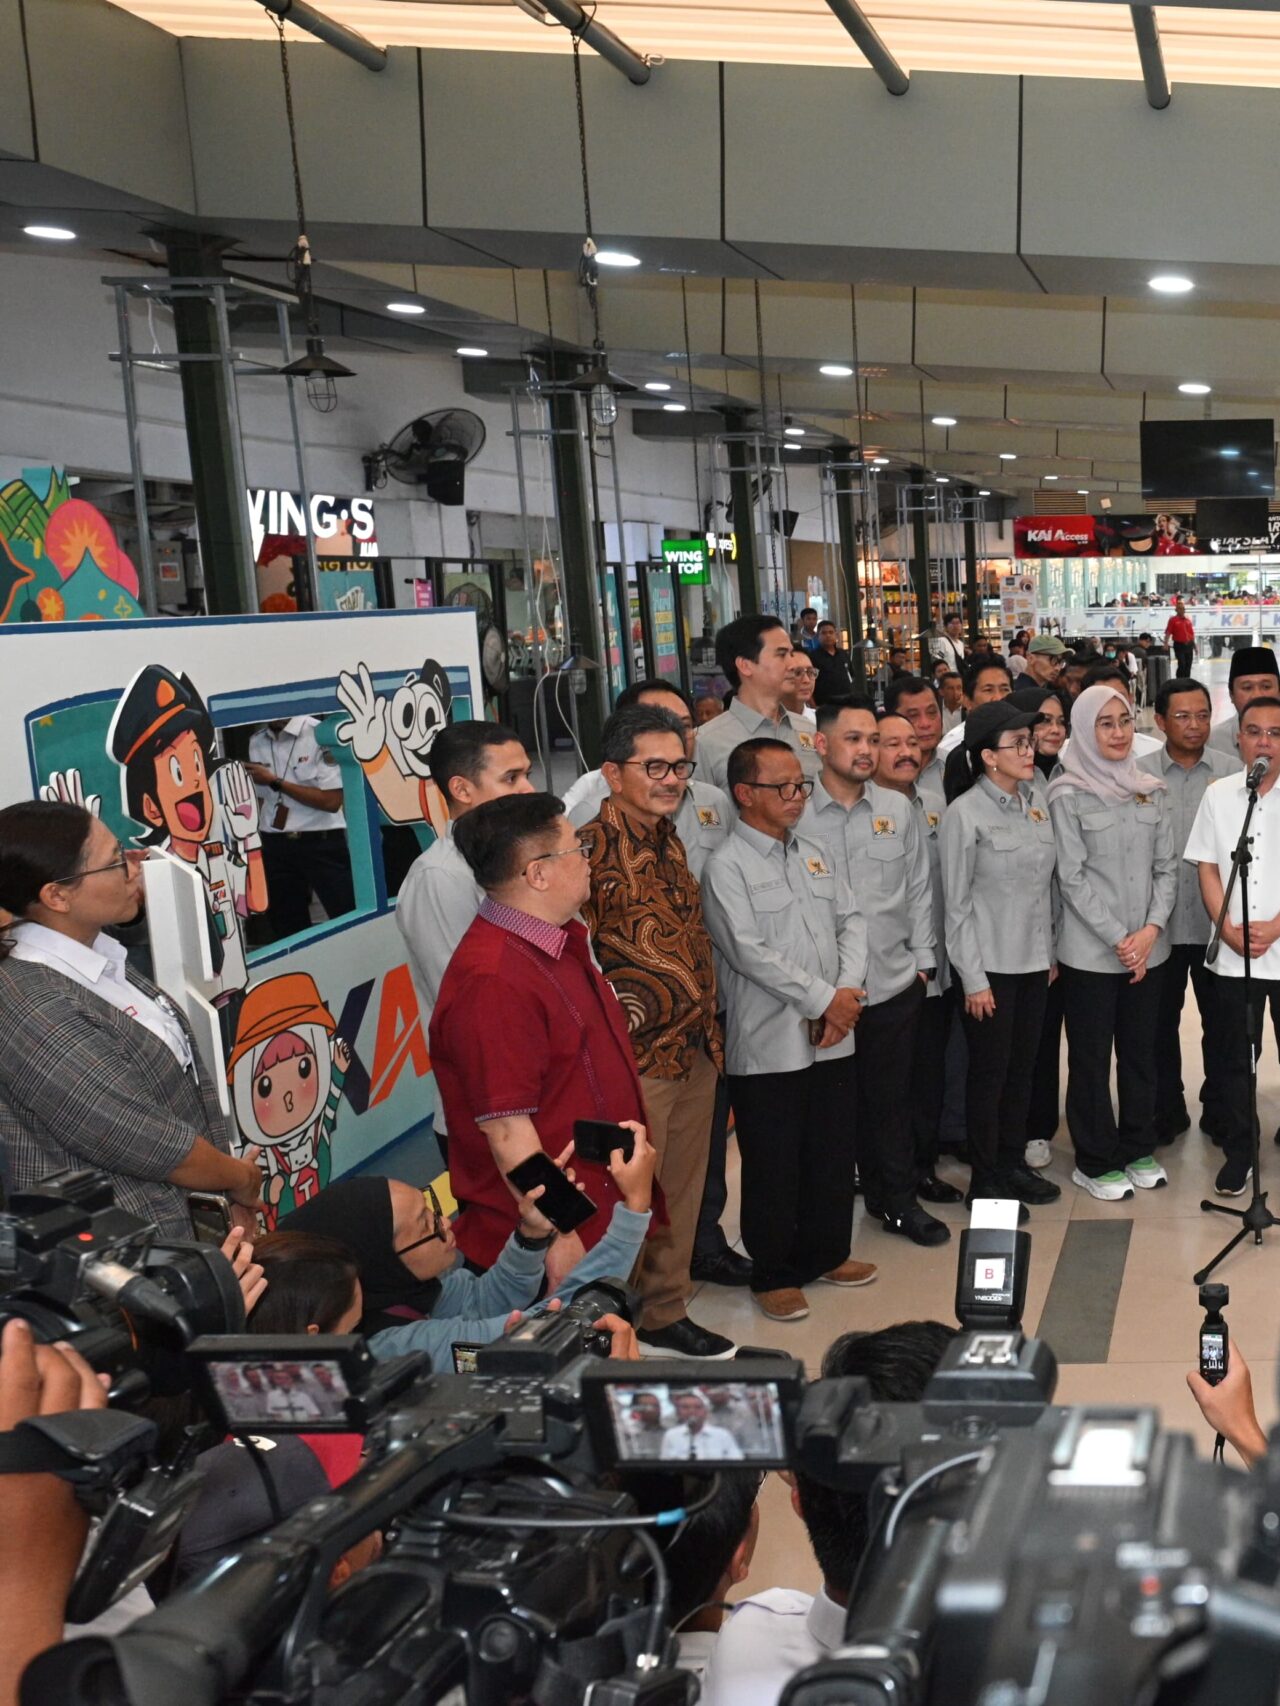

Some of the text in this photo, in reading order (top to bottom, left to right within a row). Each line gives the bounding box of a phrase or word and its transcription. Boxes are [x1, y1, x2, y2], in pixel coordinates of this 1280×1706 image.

[1027, 528, 1053, 542] KAI
[664, 550, 704, 562] WING
[667, 564, 703, 574] TOP
[985, 1268, 994, 1280] B
